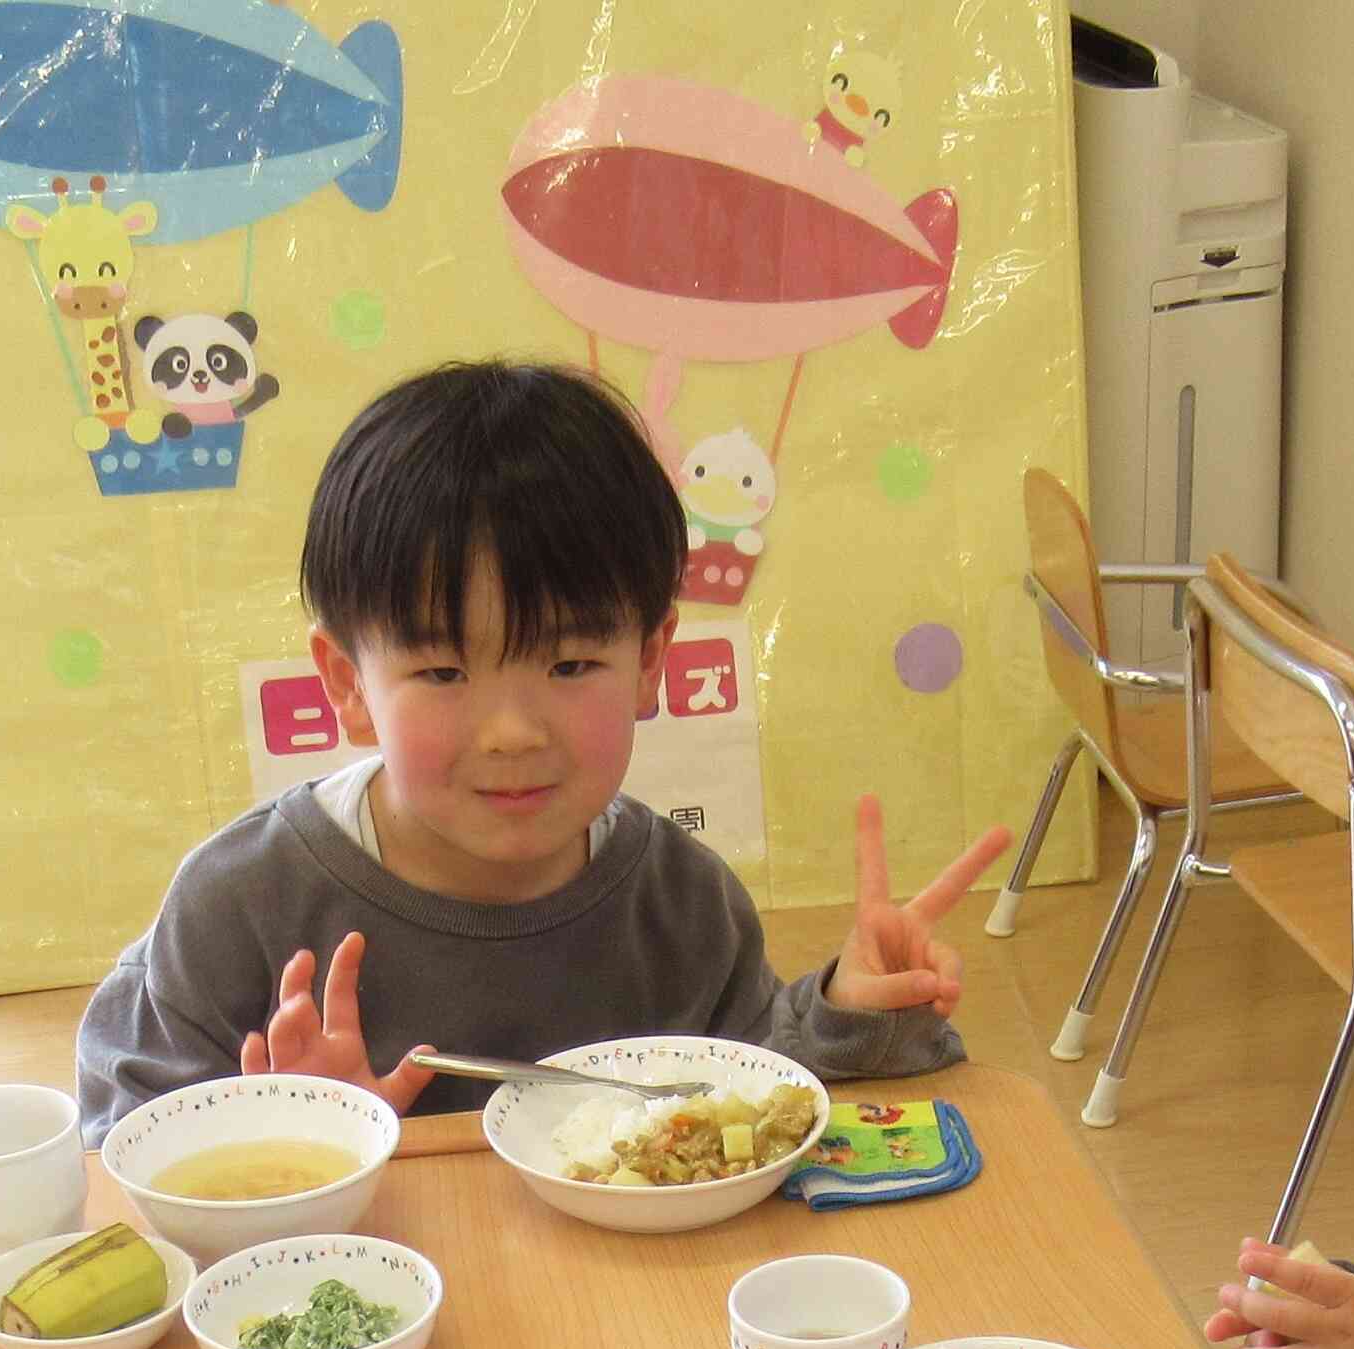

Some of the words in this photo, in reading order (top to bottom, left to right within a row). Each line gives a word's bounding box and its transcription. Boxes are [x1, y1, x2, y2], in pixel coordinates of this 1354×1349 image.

[684, 664, 732, 712] ズ
[589, 1055, 599, 1065] D
[614, 1048, 622, 1059] E
[637, 1053, 646, 1065] F
[709, 1046, 716, 1056] I
[730, 1050, 740, 1062] J
[150, 1112, 159, 1124] I
[177, 1100, 184, 1112] J
[207, 1096, 215, 1107] K
[237, 1085, 244, 1095] L
[269, 1085, 279, 1096] M
[304, 1090, 316, 1103] N
[332, 1091, 342, 1102] O
[371, 1110, 379, 1122] Q
[231, 1275, 241, 1287] H
[250, 1257, 262, 1269] I
[277, 1251, 286, 1264] J
[304, 1251, 316, 1264] K
[332, 1243, 339, 1254] L
[357, 1247, 367, 1258] M
[389, 1257, 400, 1271] N
[408, 1263, 417, 1274] O
